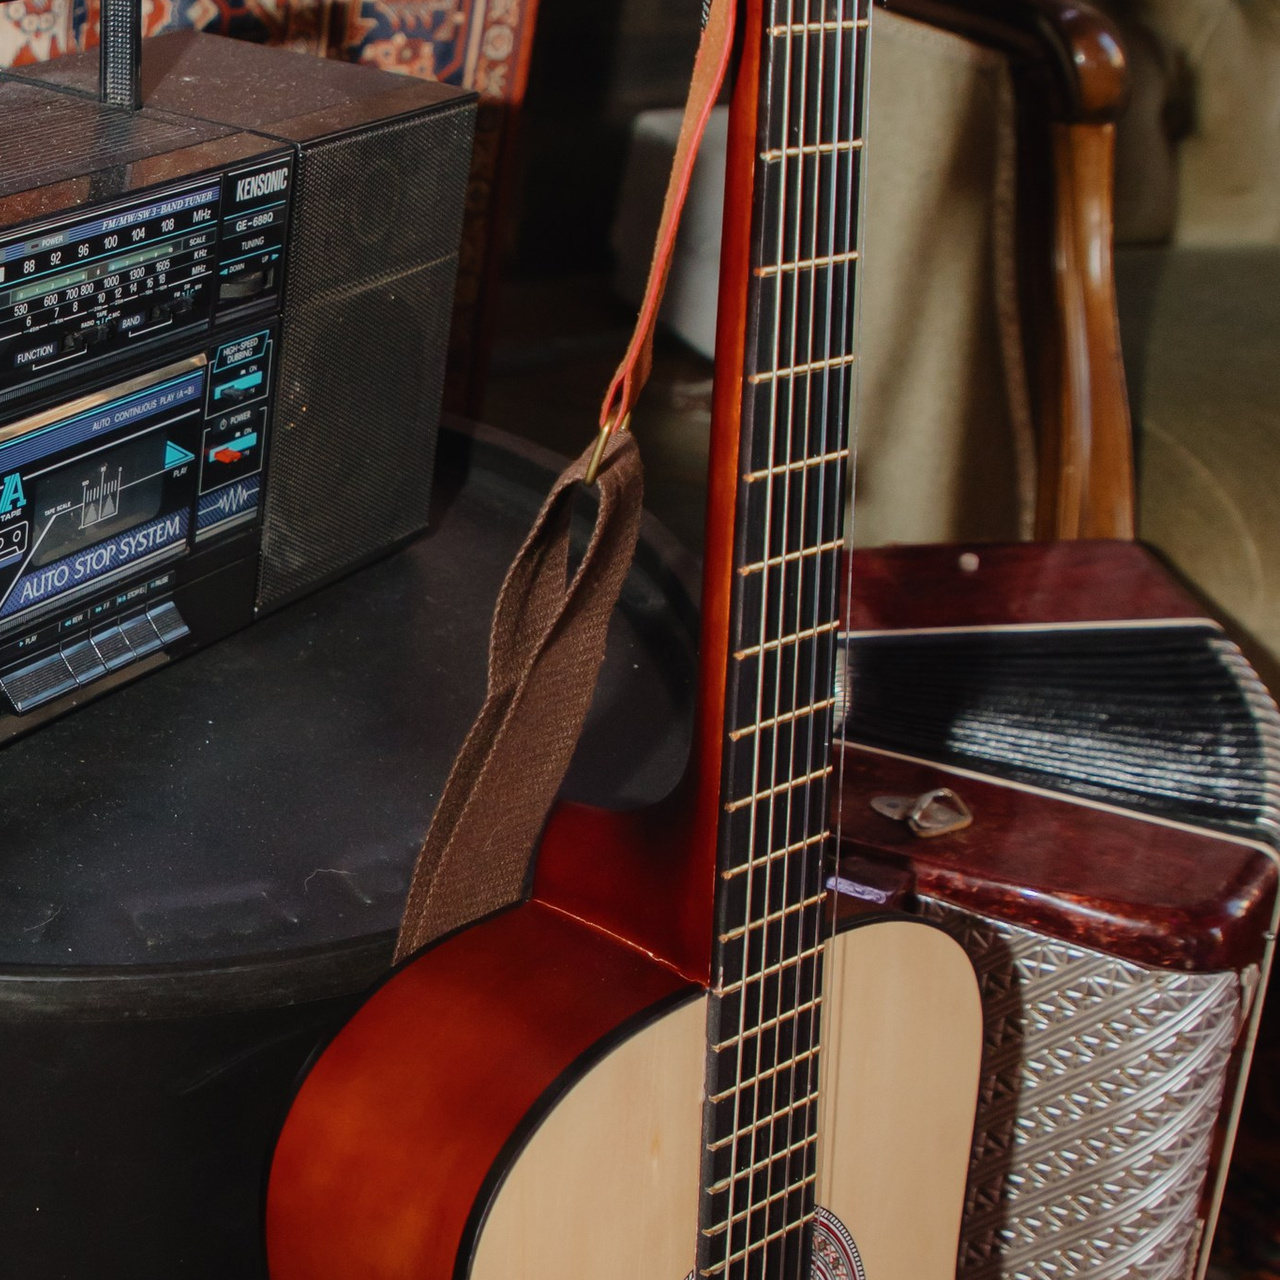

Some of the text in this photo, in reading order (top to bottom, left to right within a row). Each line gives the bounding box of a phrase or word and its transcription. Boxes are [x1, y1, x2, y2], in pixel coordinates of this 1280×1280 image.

[236, 167, 288, 202] KENSONIC
[102, 191, 213, 230] FM/MW/SW 3-BAND TUNER
[23, 208, 211, 274] 88 92 96 100 104 108 MHz
[41, 235, 64, 247] POWER
[189, 235, 206, 246] SCALE
[241, 236, 265, 250] TUNING
[261, 255, 269, 263] UP
[229, 263, 245, 273] DOWN
[14, 303, 28, 316] 530
[43, 293, 58, 307] 600
[65, 287, 79, 300] 700
[80, 283, 94, 296] 800
[103, 274, 120, 288] 1000
[129, 267, 145, 280] 1300
[155, 259, 170, 272] 1605
[193, 248, 207, 260] KHz
[26, 315, 32, 327] 6
[54, 307, 59, 318] 7
[72, 301, 79, 312] 8
[97, 292, 106, 303] 10
[114, 287, 122, 299] 12
[129, 282, 137, 293] 14
[146, 277, 154, 288] 16
[158, 273, 166, 284] 18
[191, 264, 206, 275] MHz
[96, 310, 108, 318] TAPE
[80, 320, 95, 329] RADIO
[122, 315, 141, 329] BAND
[17, 344, 53, 364] FUNCTION
[223, 337, 259, 357] HIGH-SPEED
[227, 348, 253, 364] DUBBING
[249, 365, 258, 373] ON
[92, 417, 111, 431] AUTO
[114, 399, 157, 423] CONTINUOUS
[160, 393, 175, 406] PLAY
[230, 410, 252, 425] POWER
[244, 427, 252, 435] ON
[173, 466, 188, 478] PLAY
[0, 508, 22, 522] TAPE
[44, 501, 71, 516] TAPE SCALE
[20, 515, 180, 604] AUTO STOP SYSTEM
[25, 634, 38, 645] PLAY
[72, 614, 84, 624] REW
[155, 575, 169, 586] PAUSE
